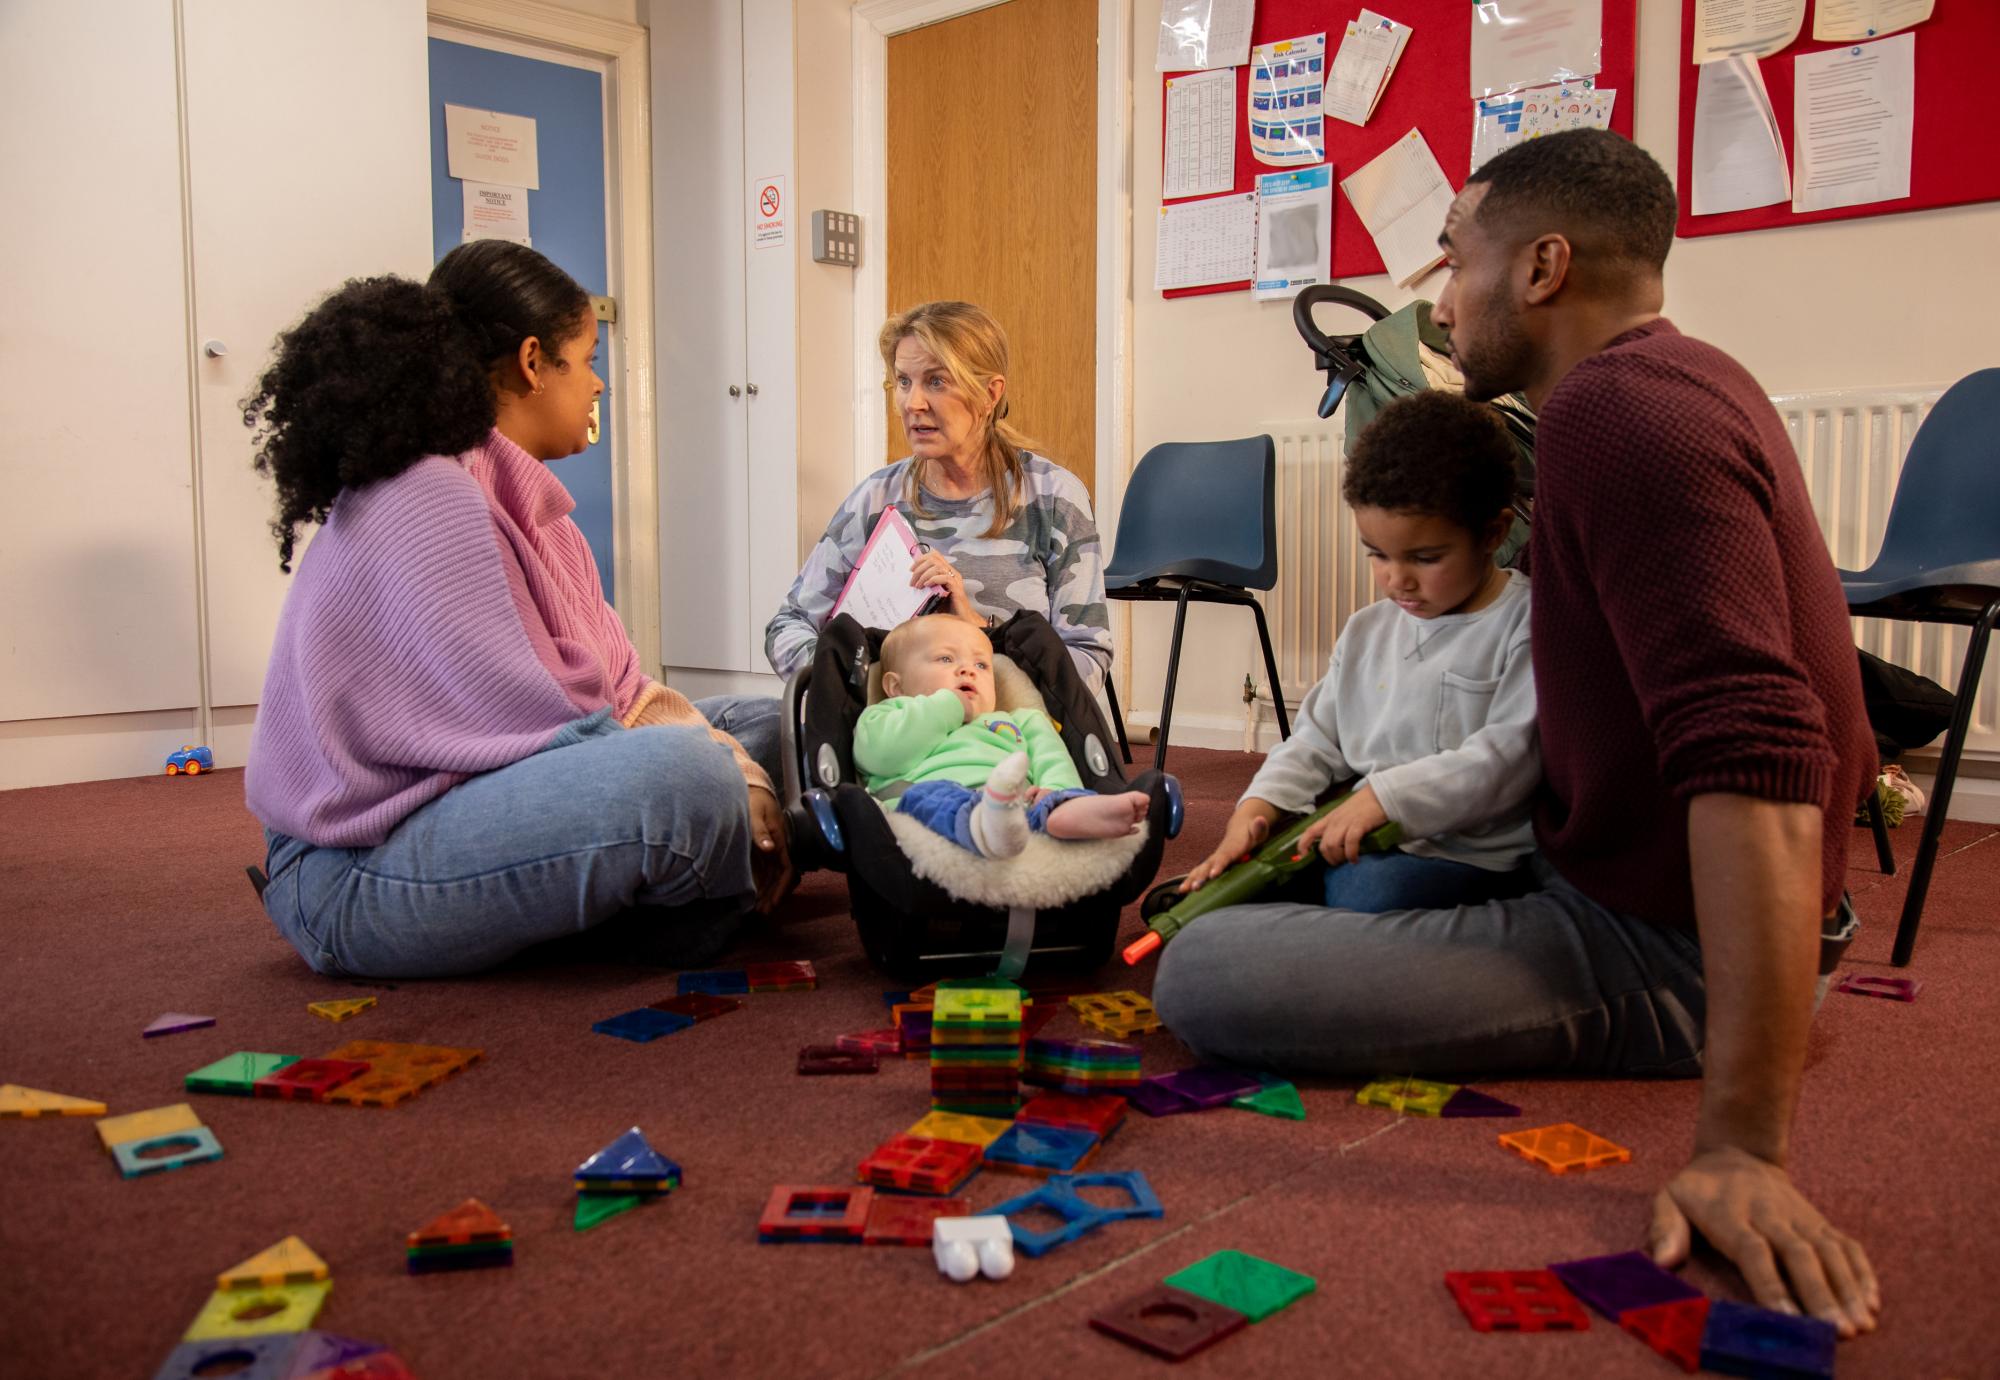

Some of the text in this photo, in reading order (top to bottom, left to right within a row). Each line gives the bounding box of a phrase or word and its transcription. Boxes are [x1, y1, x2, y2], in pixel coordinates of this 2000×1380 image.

[479, 190, 512, 201] IMPORTANT
[485, 198, 506, 206] NOTICE
[756, 219, 783, 231] NO SMOKING
